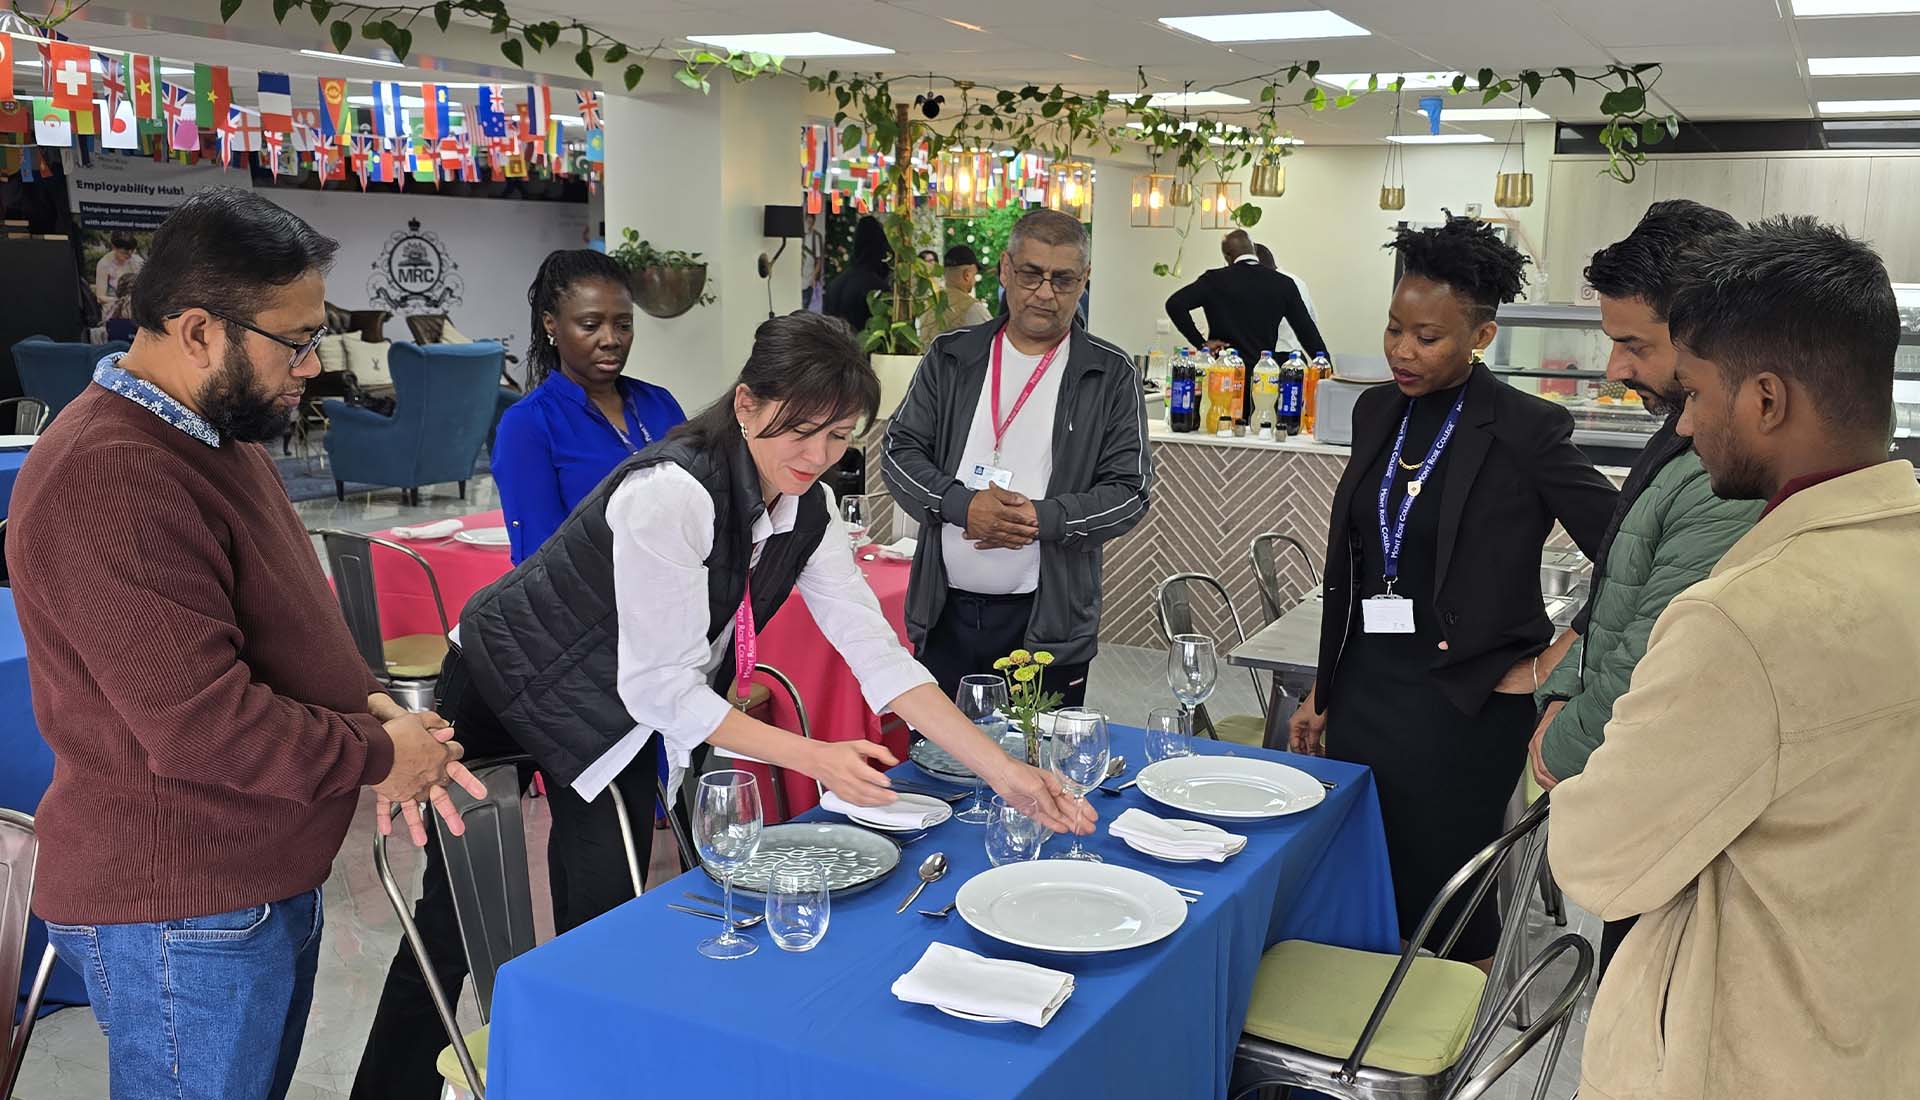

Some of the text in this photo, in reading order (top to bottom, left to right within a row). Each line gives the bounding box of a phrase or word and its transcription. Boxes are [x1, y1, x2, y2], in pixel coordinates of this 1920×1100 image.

[76, 180, 185, 196] Employability Hub!
[398, 268, 435, 283] MRC
[1427, 449, 1441, 465] ROSE
